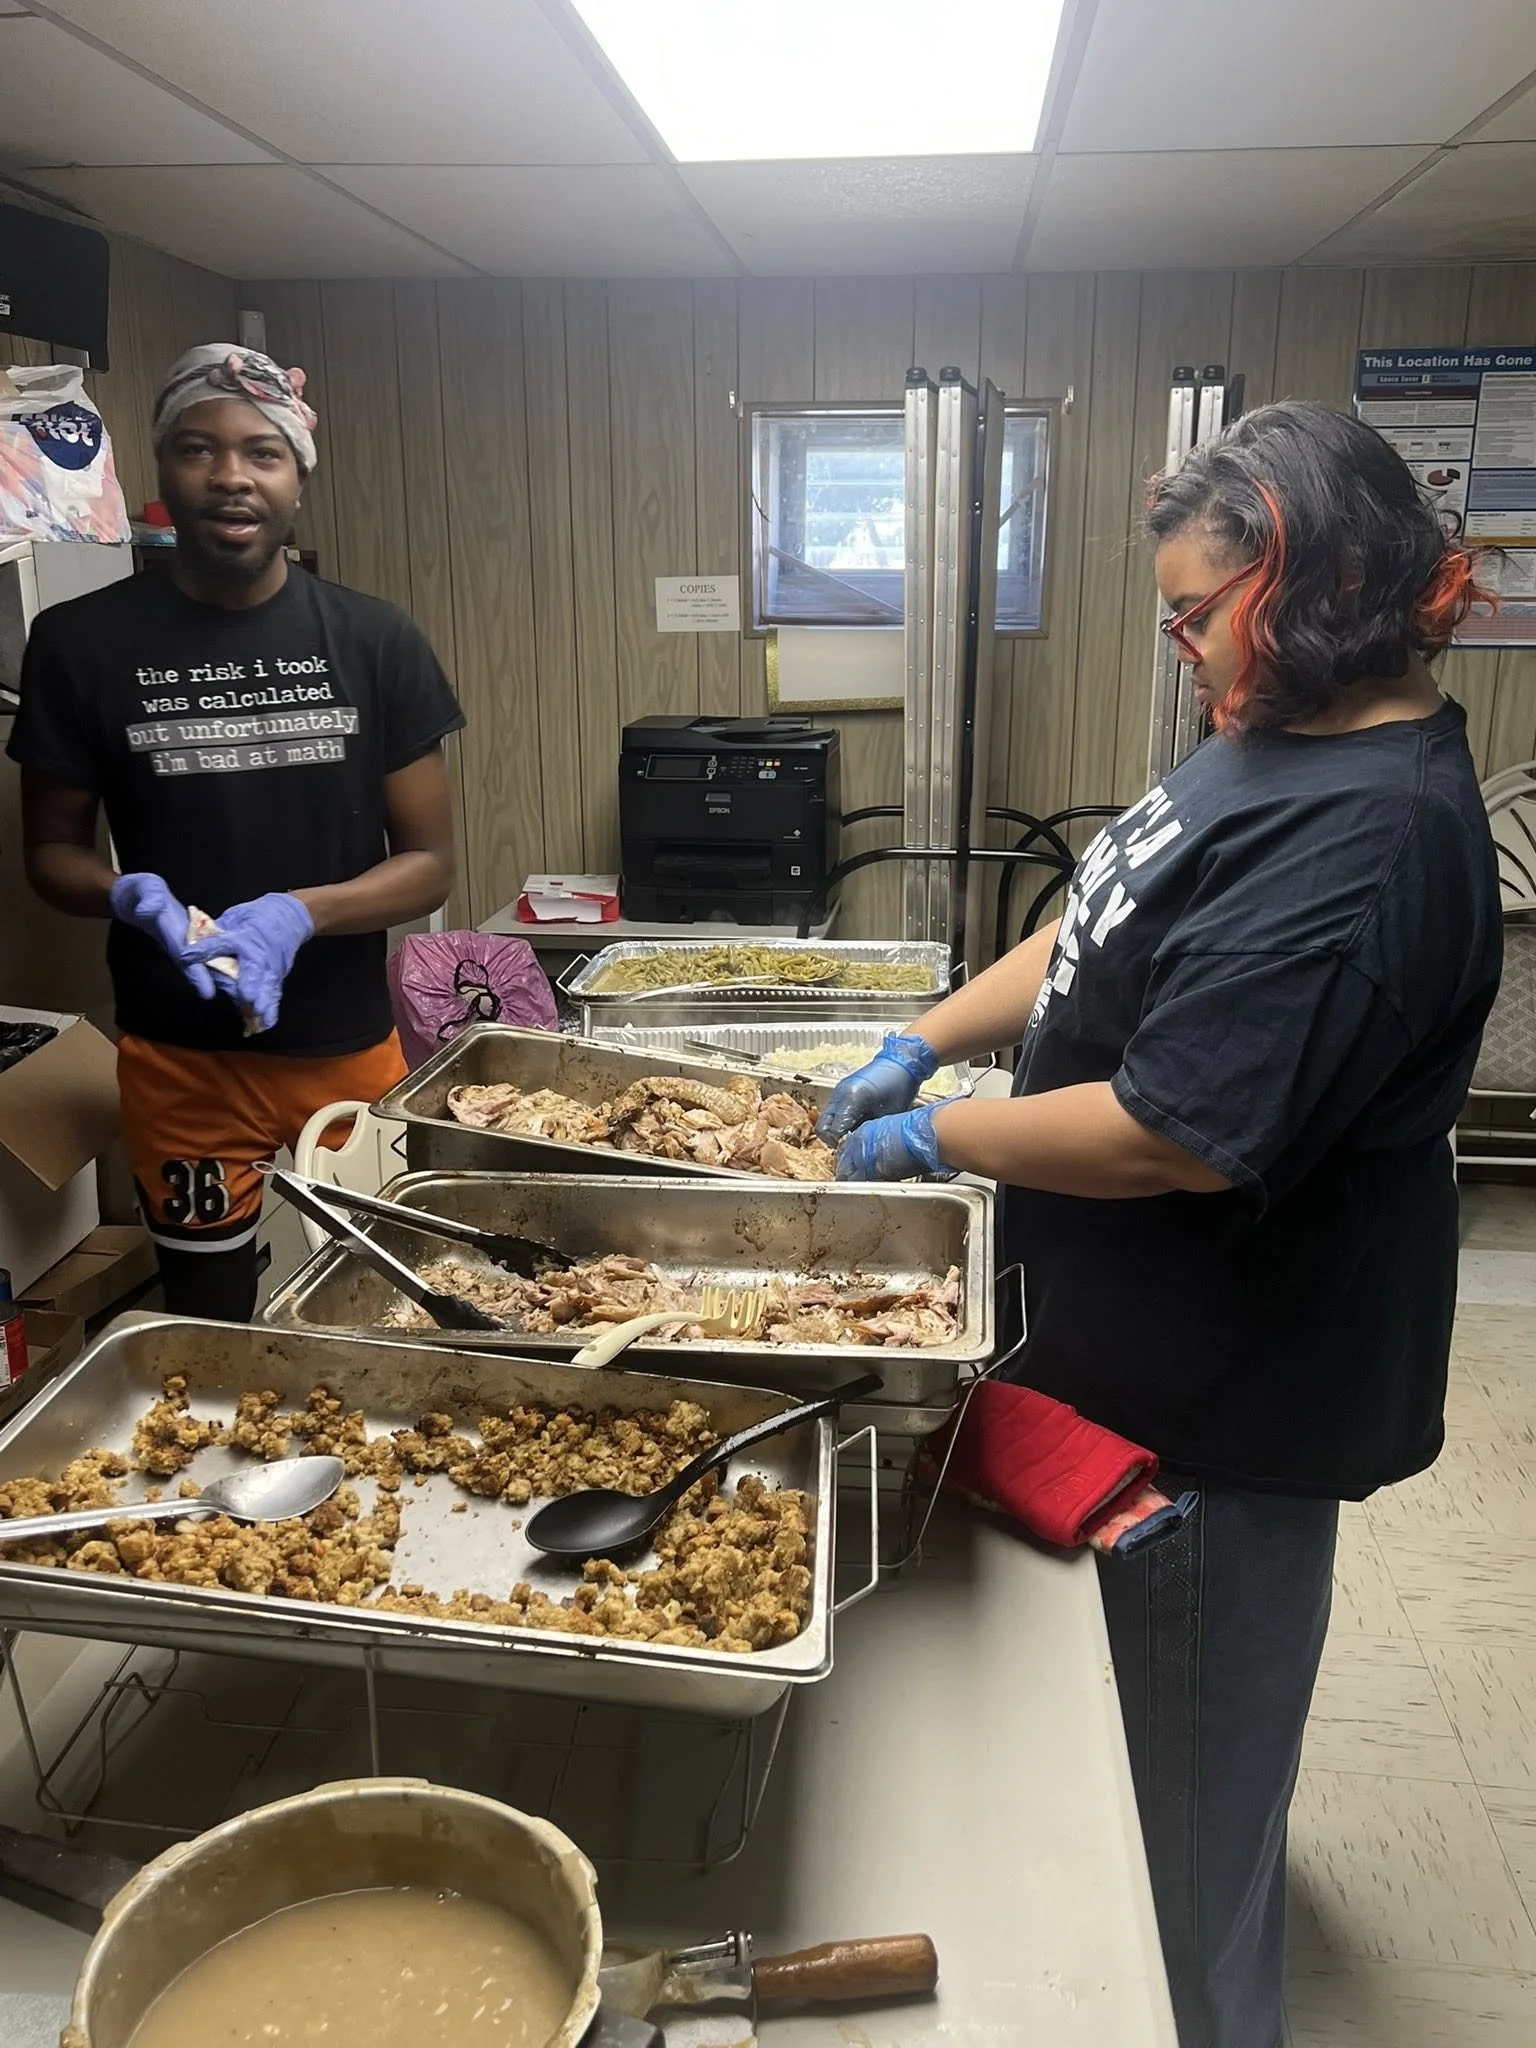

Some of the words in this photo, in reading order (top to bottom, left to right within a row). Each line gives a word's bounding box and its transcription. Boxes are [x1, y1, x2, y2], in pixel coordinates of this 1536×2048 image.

[1364, 356, 1393, 368] This
[1398, 355, 1459, 368] Location
[1463, 355, 1491, 367] Has
[1495, 354, 1533, 366] Gone
[679, 584, 717, 594] COPIES
[136, 667, 179, 686] the
[188, 662, 246, 682] risk
[253, 659, 269, 677] i
[275, 656, 329, 675] took
[142, 695, 190, 713] was
[199, 682, 335, 710] calculated
[127, 724, 170, 746] but
[177, 710, 358, 740] unfortunately
[153, 751, 189, 773] i'm
[197, 749, 241, 769] bad
[249, 746, 278, 766] at
[286, 741, 345, 763] math
[161, 1159, 231, 1224] 36
